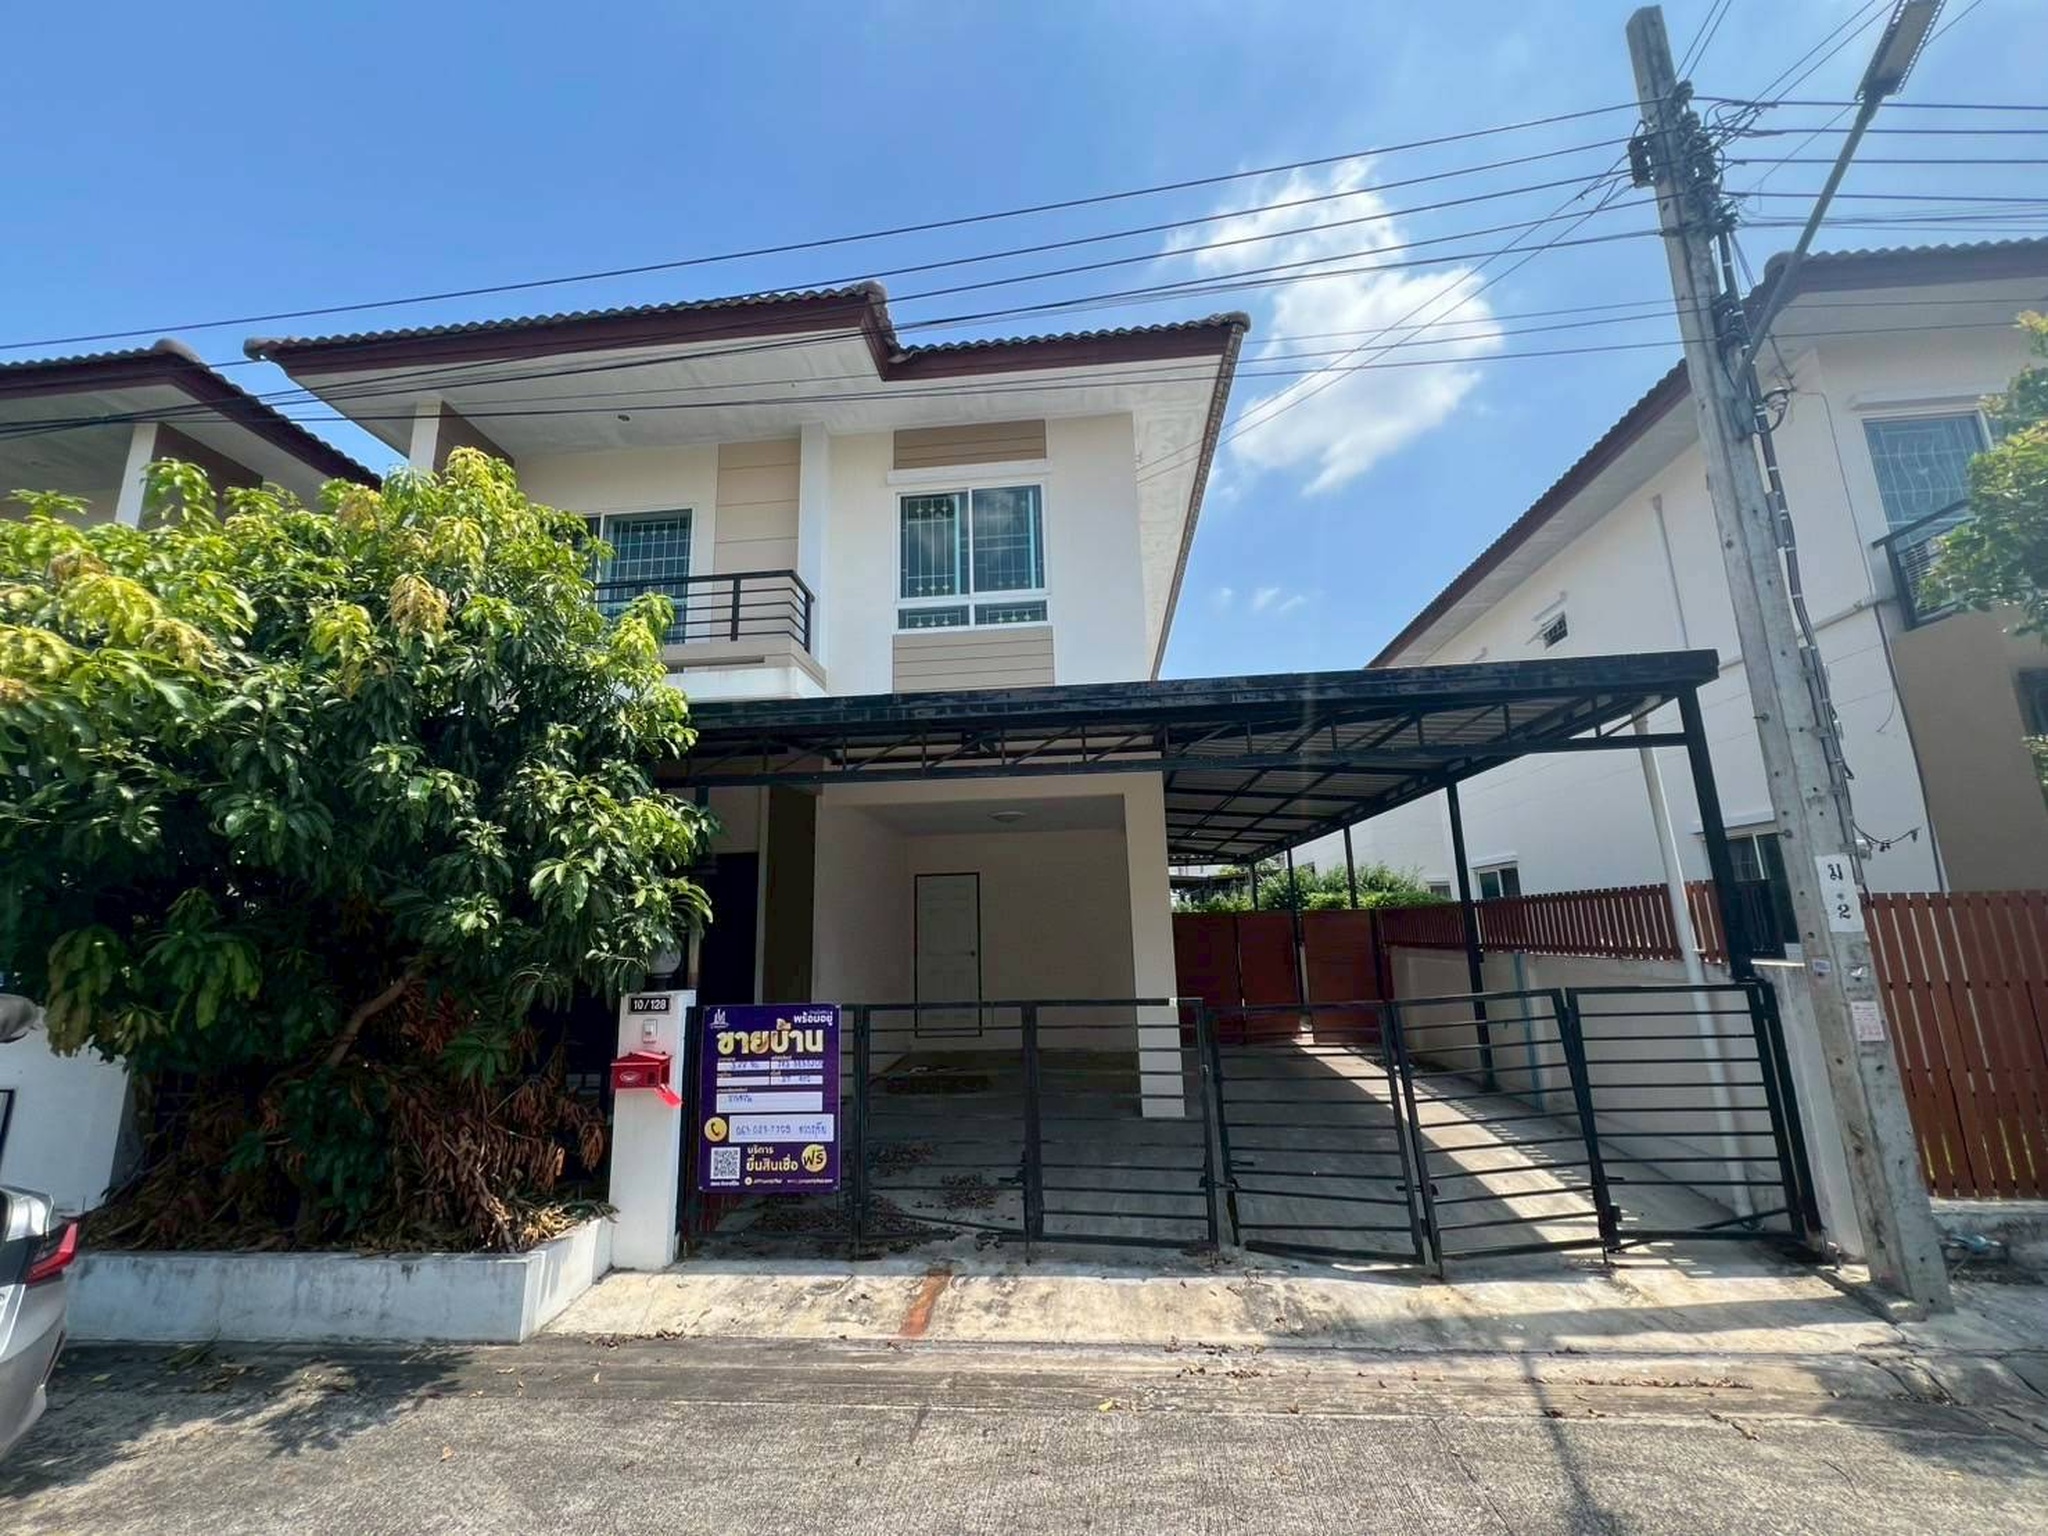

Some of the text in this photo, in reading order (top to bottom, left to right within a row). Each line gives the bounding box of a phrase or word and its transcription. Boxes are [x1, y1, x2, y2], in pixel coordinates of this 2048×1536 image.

[633, 999, 667, 1010] 10/128
[793, 1011, 833, 1027] พร้อมอยู่
[716, 1018, 824, 1055] ขายบ้าน
[747, 1145, 774, 1154] บริการ
[803, 1149, 824, 1166] ฟรี
[745, 1153, 799, 1172] ยื่นสินเชื่อ
